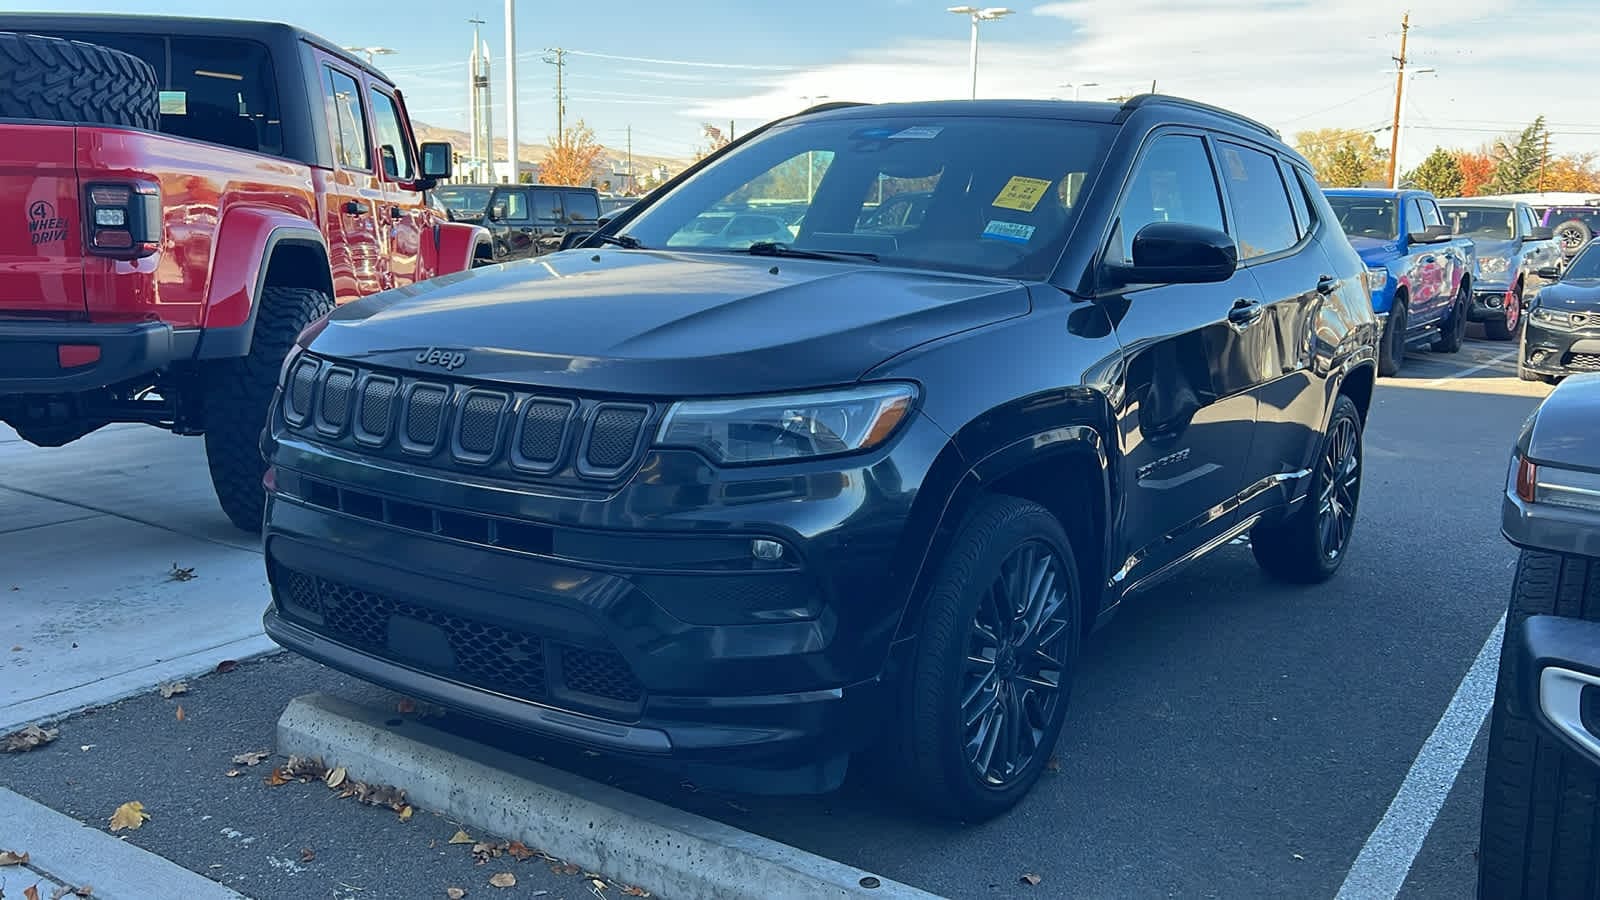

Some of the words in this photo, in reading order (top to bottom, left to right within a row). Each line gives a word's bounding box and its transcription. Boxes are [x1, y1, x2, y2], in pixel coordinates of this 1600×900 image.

[33, 203, 46, 218] 4
[29, 217, 69, 232] WHEEL
[32, 230, 68, 245] DRIVE
[415, 346, 466, 371] Jeep
